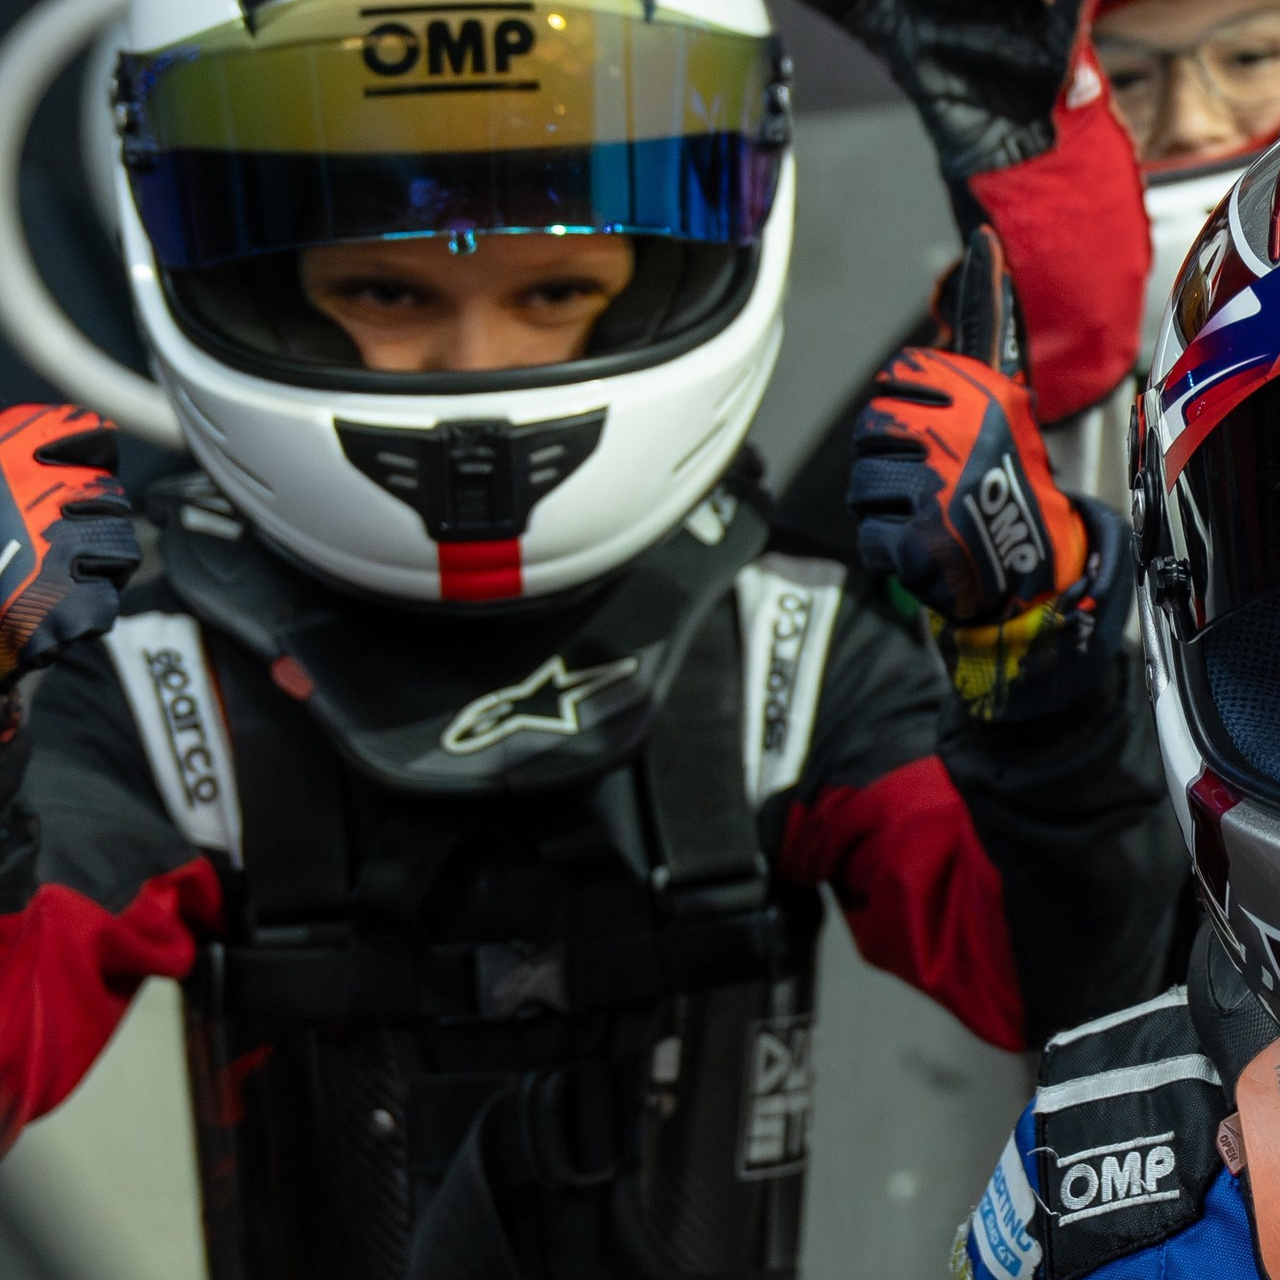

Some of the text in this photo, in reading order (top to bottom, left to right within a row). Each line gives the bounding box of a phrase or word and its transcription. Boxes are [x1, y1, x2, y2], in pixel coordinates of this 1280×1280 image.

[363, 18, 535, 77] OMP
[980, 466, 1040, 574] OMP
[147, 646, 220, 805] sparco
[1059, 1145, 1176, 1211] OMP
[1219, 1134, 1239, 1163] OPEN
